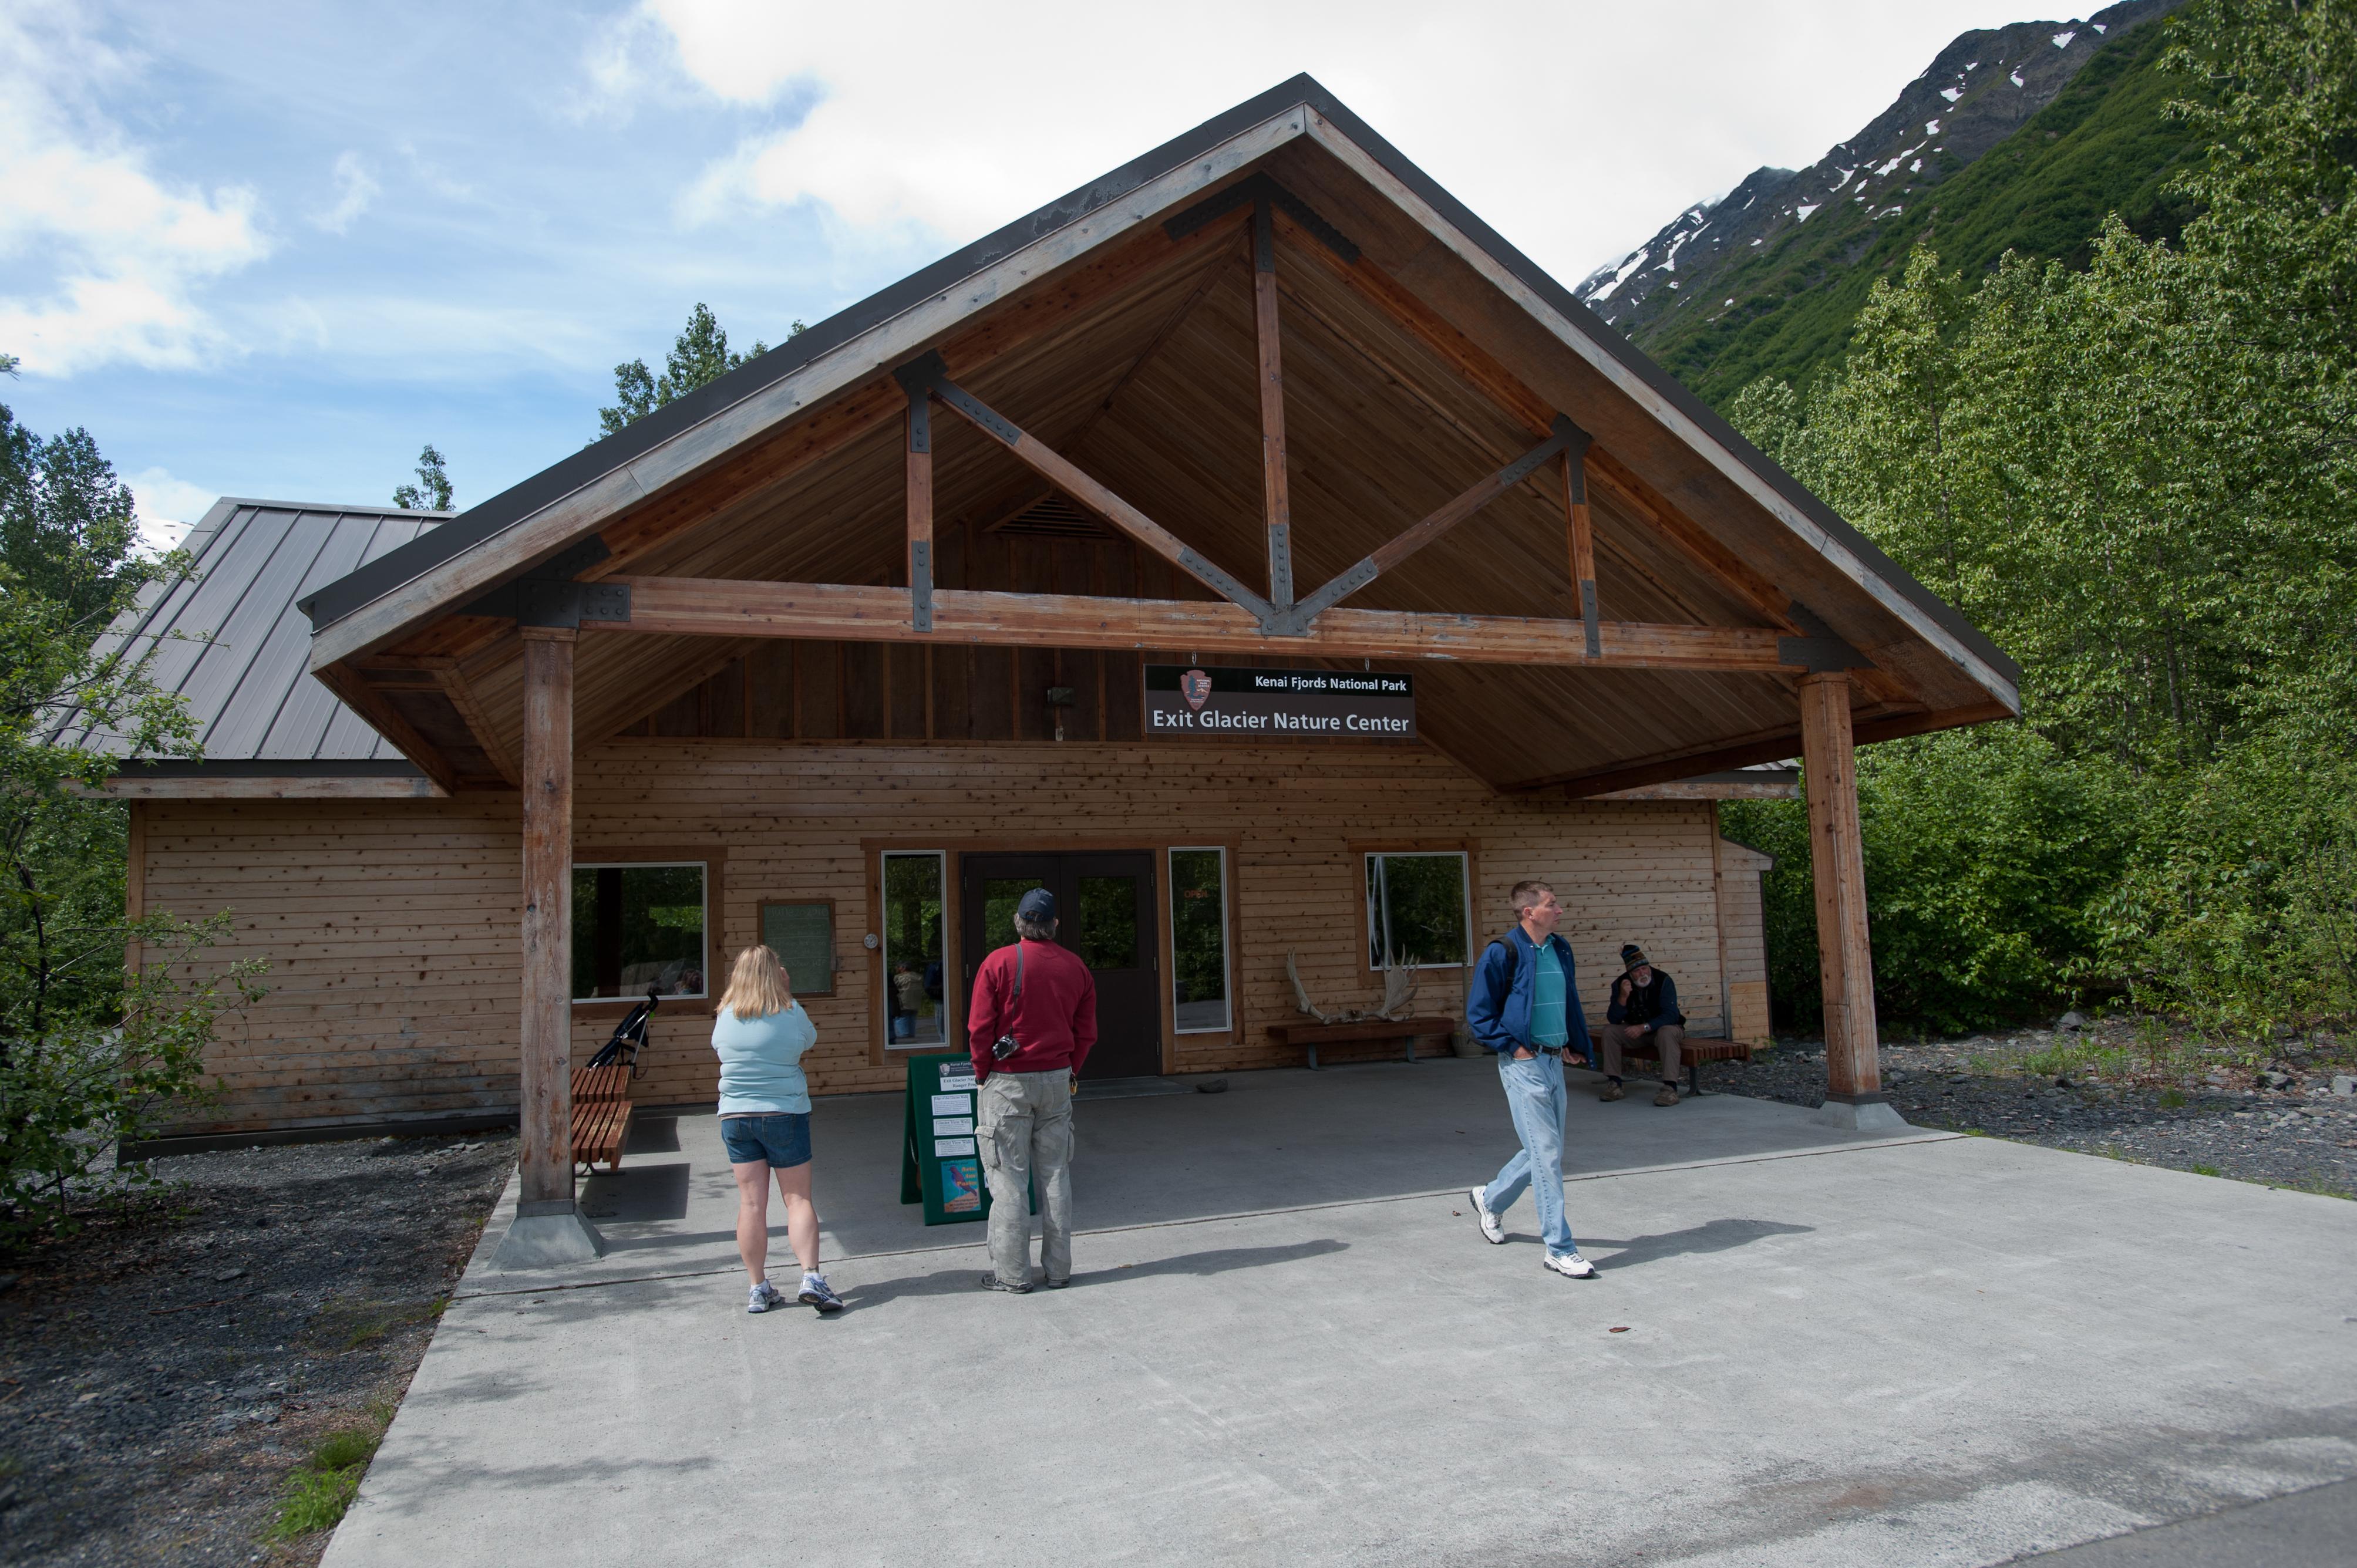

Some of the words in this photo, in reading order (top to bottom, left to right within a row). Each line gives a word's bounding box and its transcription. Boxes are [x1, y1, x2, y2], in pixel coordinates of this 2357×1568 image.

[1255, 676, 1288, 687] Kenai
[1291, 676, 1327, 690] Fjords
[1330, 678, 1378, 690] National
[1382, 680, 1407, 692] Park
[1153, 709, 1194, 727] Exit
[1199, 710, 1268, 729] Glacier
[1274, 712, 1341, 730] Nature
[1346, 714, 1409, 731] Center
[1184, 890, 1208, 898] OPEN
